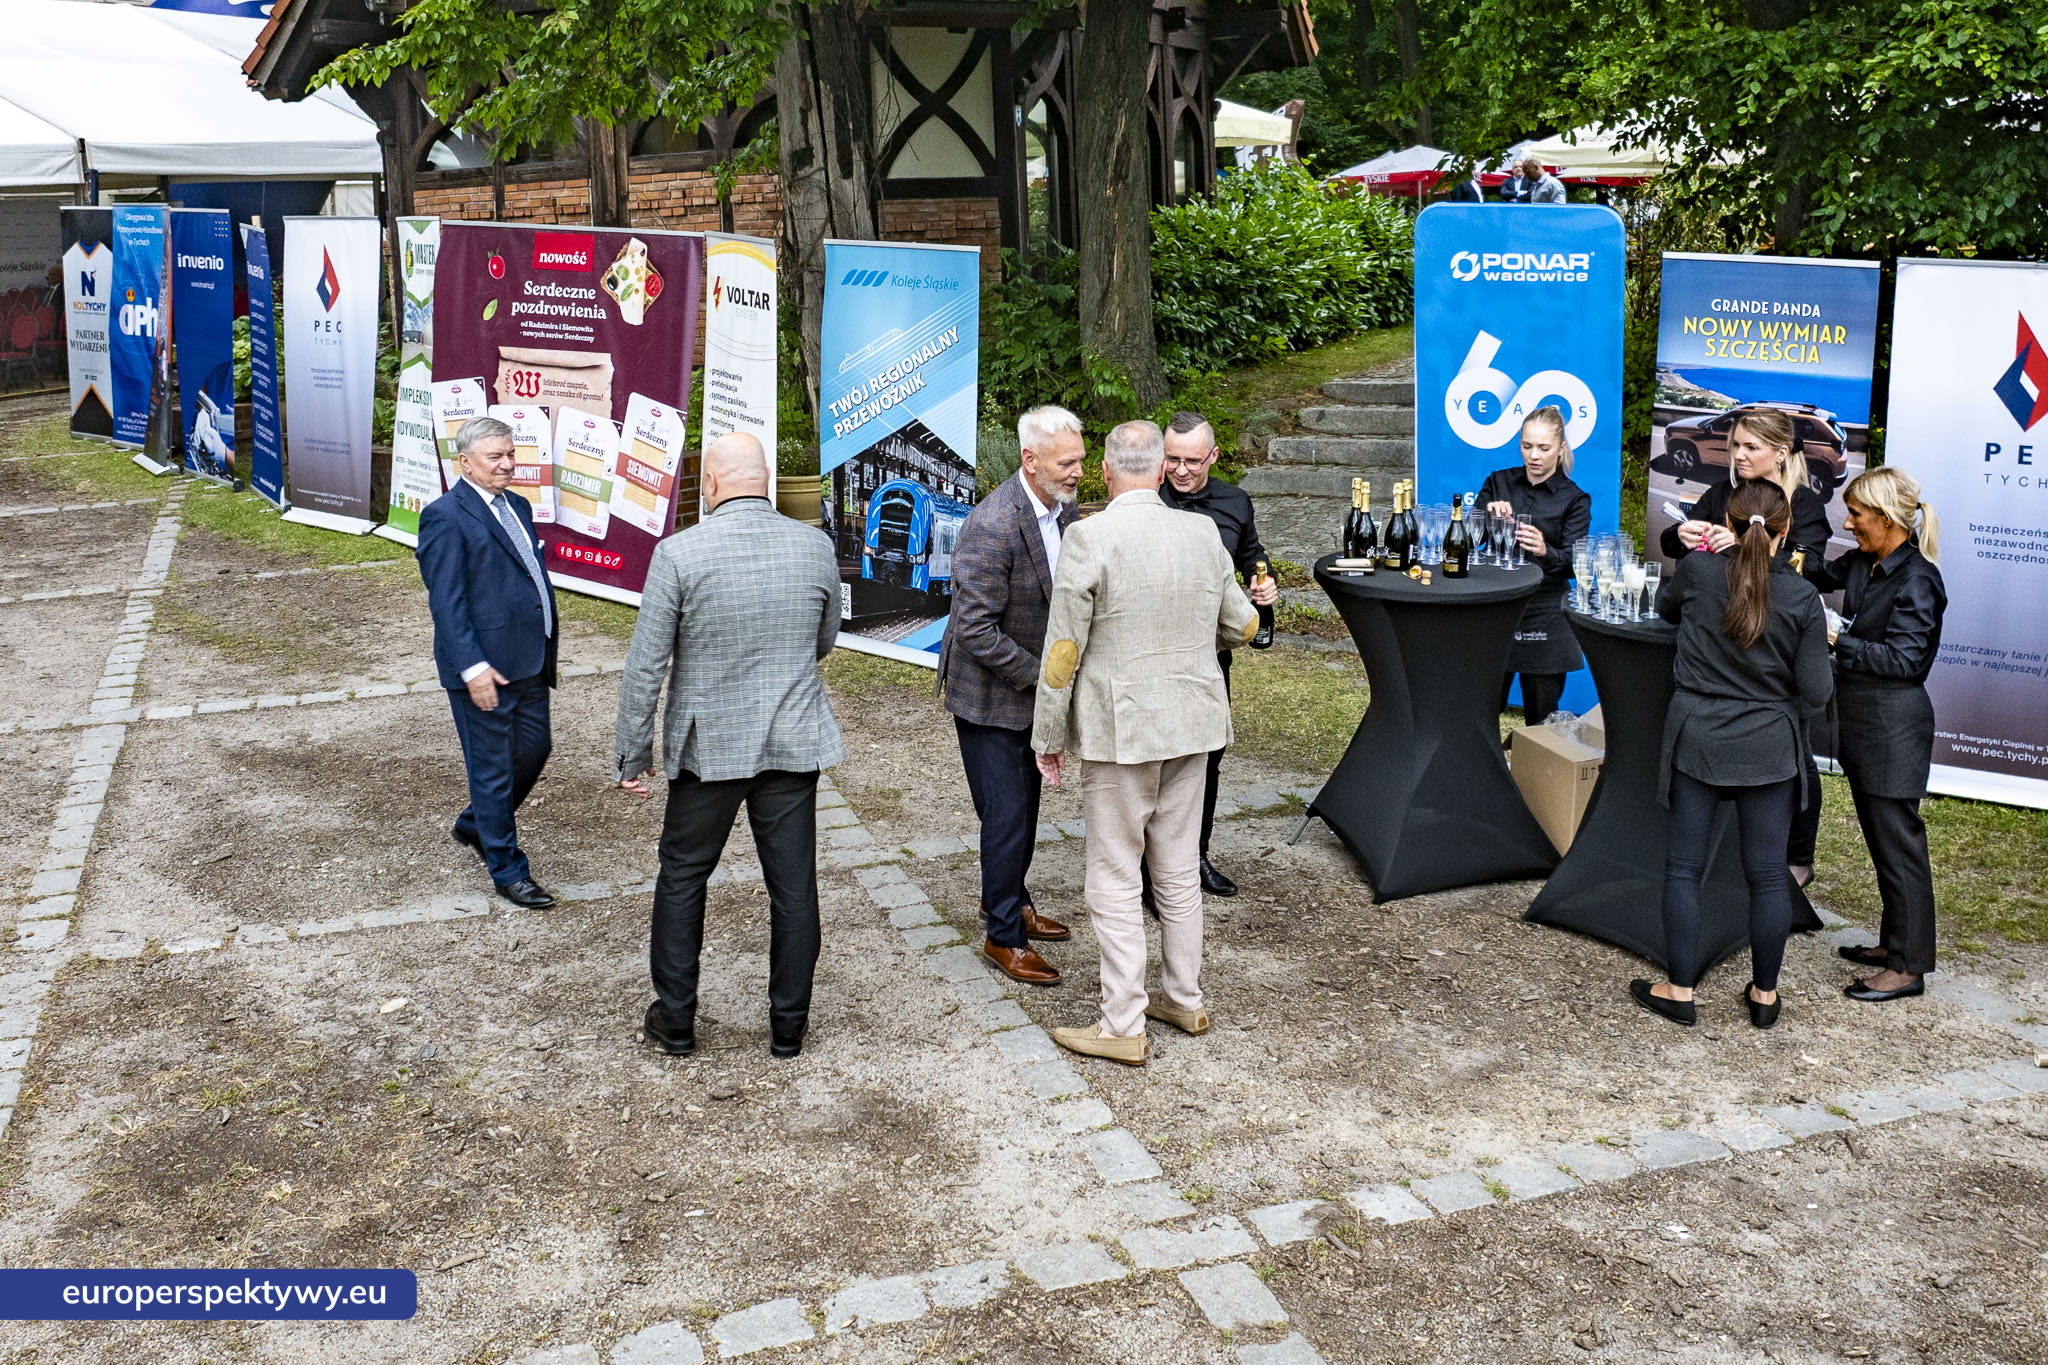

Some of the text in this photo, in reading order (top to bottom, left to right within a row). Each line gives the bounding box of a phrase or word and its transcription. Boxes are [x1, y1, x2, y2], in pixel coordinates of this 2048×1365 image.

[1363, 174, 1390, 184] TYSKIE
[177, 253, 225, 271] invenio
[539, 251, 588, 265] nowość
[1482, 252, 1590, 270] PONAR
[891, 273, 960, 293] Koleje Śląskie
[1483, 270, 1589, 282] wadowice
[523, 280, 597, 299] Serdeczne
[726, 285, 771, 311] VOLTAR
[510, 301, 608, 320] pozdrowienia
[735, 307, 758, 321] SYSTEM
[1711, 299, 1821, 318] GRANDE PANDA
[314, 319, 343, 333] PEC
[520, 320, 529, 328] od
[528, 320, 559, 330] Radzimira
[562, 323, 594, 333] Siemowita
[1683, 316, 1847, 345] NOWY WYMIAR
[75, 329, 106, 342] PARTNER
[522, 330, 546, 339] nowych
[545, 332, 564, 340] serów
[564, 332, 596, 344] Serdeczny
[1704, 337, 1821, 365] SZCZĘŚCIA
[828, 325, 960, 419] TWÓJ REGIONALNY
[443, 407, 476, 418] Serdeczny
[832, 372, 927, 440] PRZEWOŹNIK
[513, 434, 538, 444] deczny
[635, 425, 669, 448] Serdeczny
[568, 437, 606, 457] Serdeczny
[512, 465, 542, 480] MOWIT
[560, 469, 603, 494] RADZIMIR
[626, 459, 664, 488] SIEMOWIT
[1984, 473, 2048, 489] TYCH
[1463, 491, 1479, 506] 6
[1977, 550, 2048, 565] oszczędno
[1938, 642, 2009, 660] ostarczamy
[2011, 650, 2041, 663] tanie
[1970, 659, 1981, 668] w
[1983, 661, 2042, 678] najlepszej
[1959, 733, 2001, 746] Energetyki
[2002, 739, 2035, 752] Cieplnej
